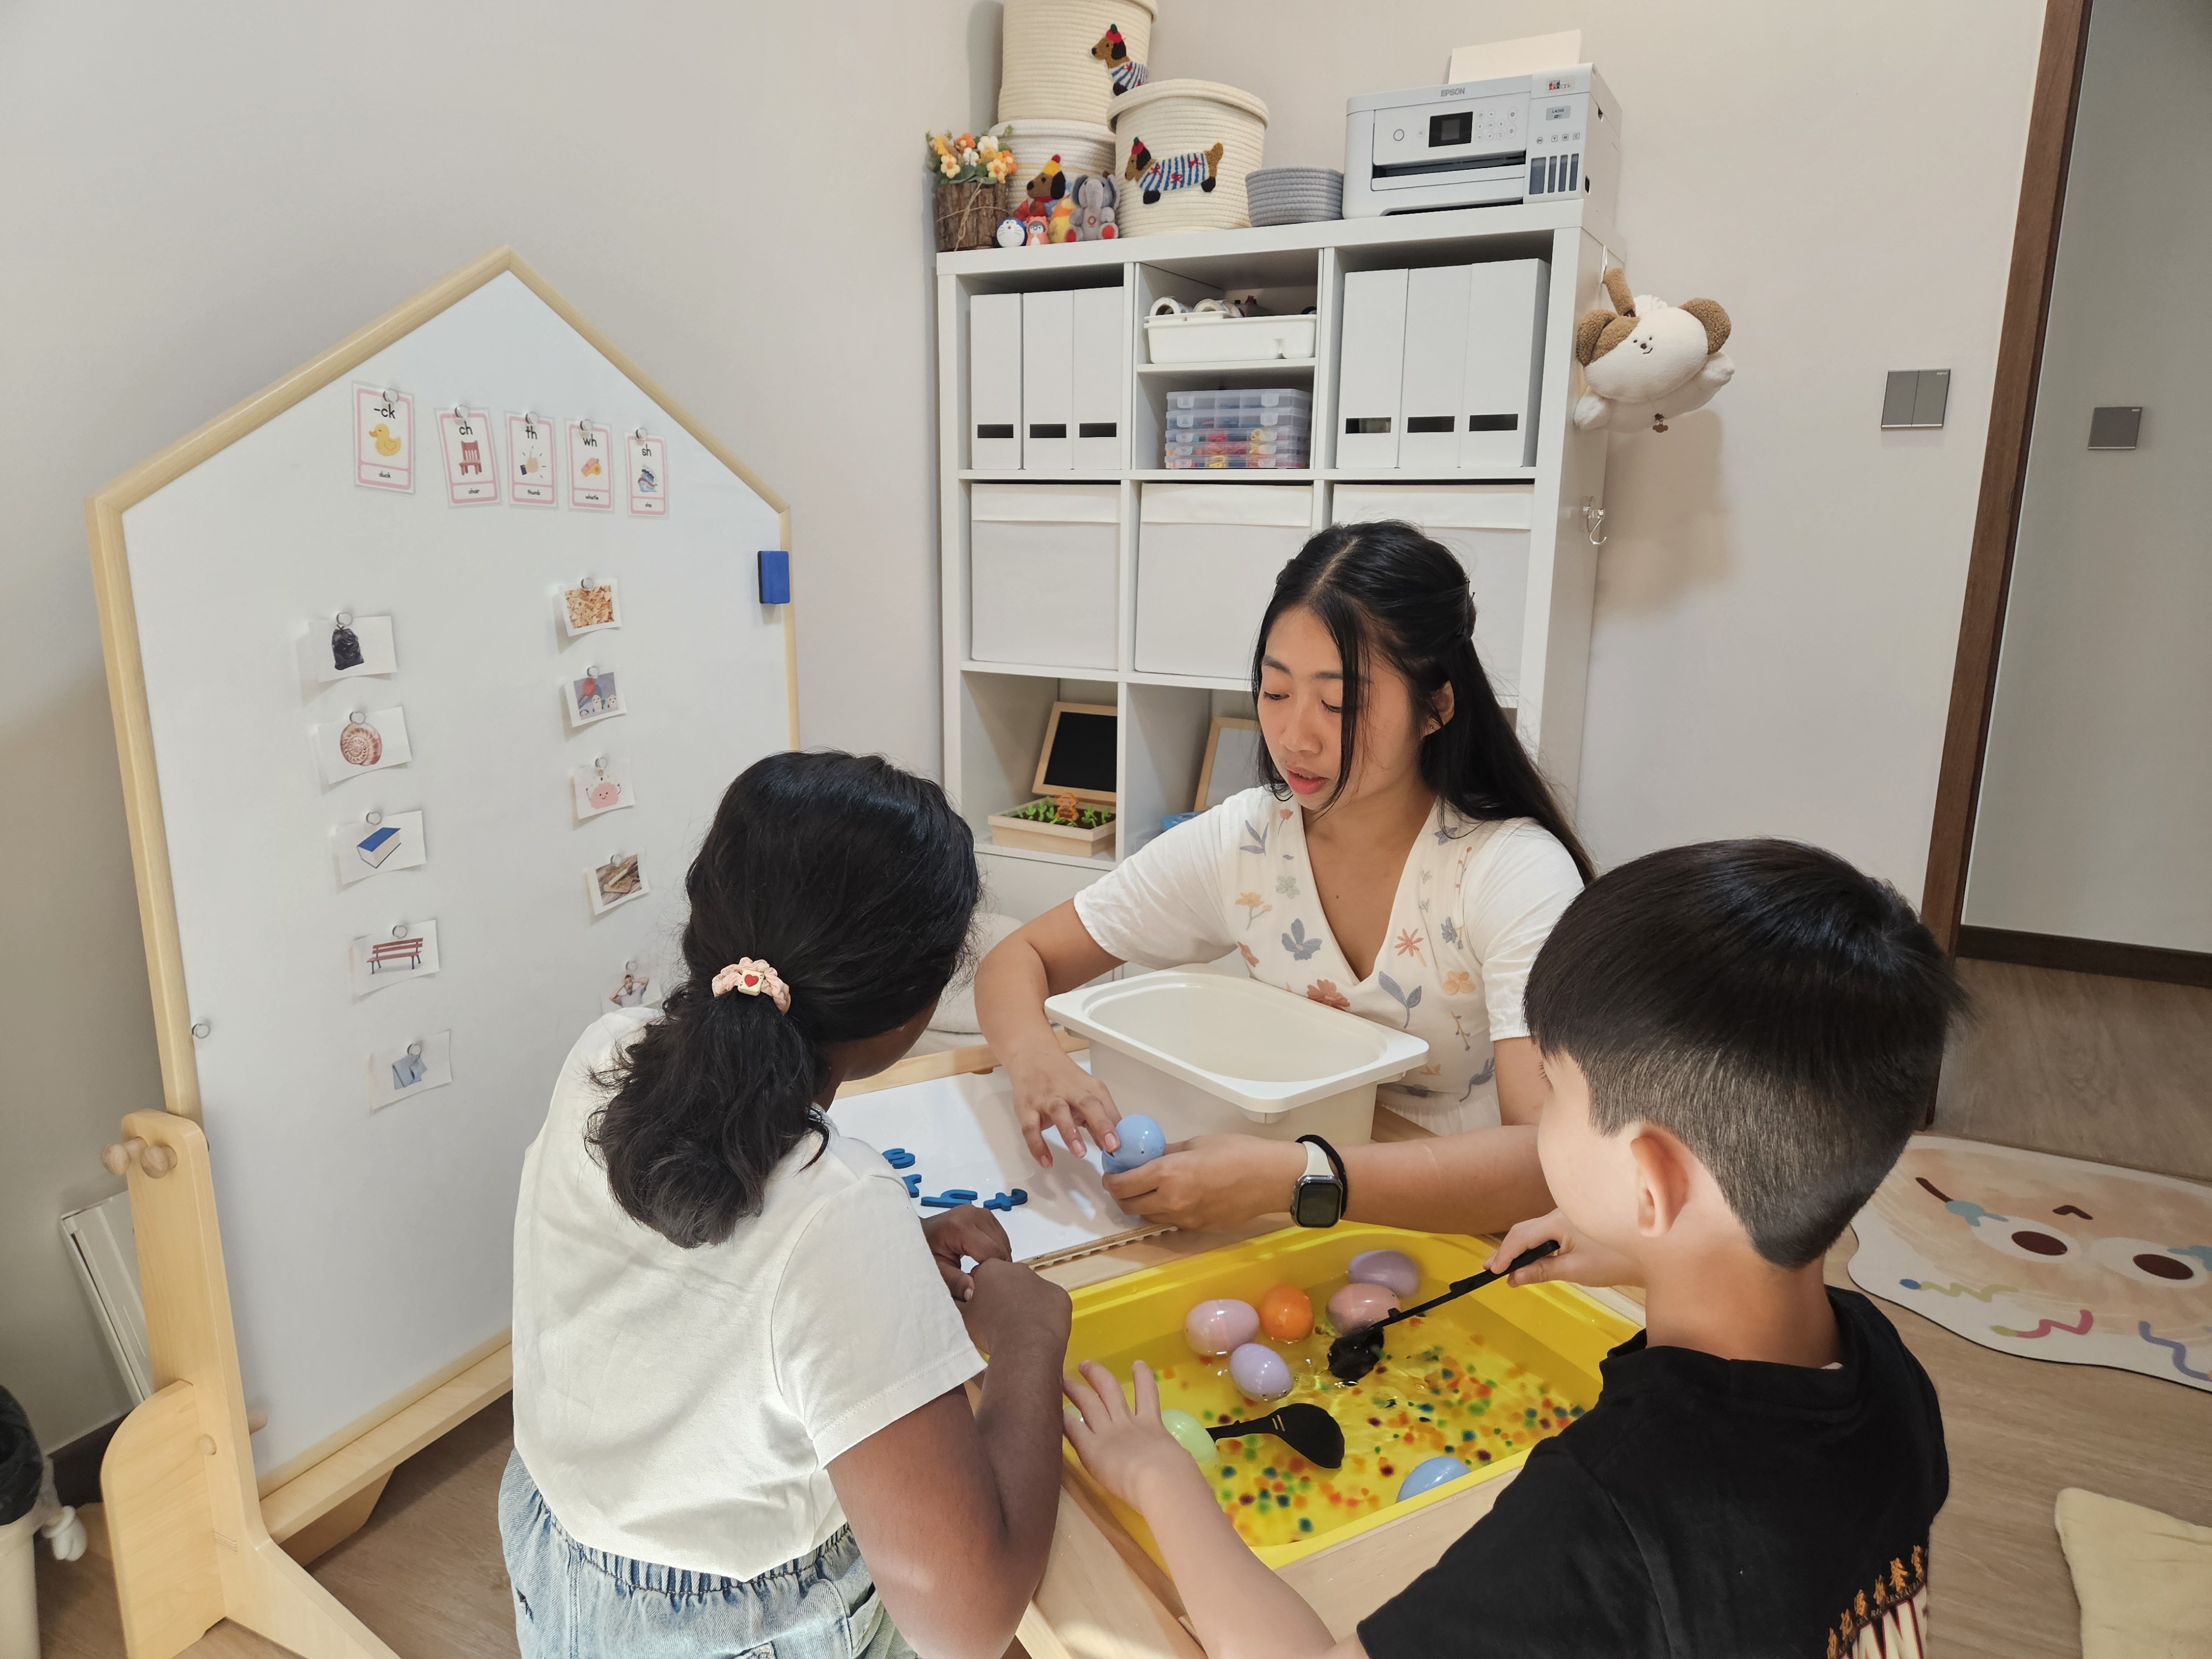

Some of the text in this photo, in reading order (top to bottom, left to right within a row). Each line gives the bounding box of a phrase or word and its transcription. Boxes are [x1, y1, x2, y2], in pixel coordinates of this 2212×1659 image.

[1440, 87, 1465, 97] EPSON
[373, 403, 396, 419] -ck
[458, 420, 473, 435] ch
[525, 425, 538, 440] th
[583, 433, 597, 447] wh
[641, 444, 652, 457] sh
